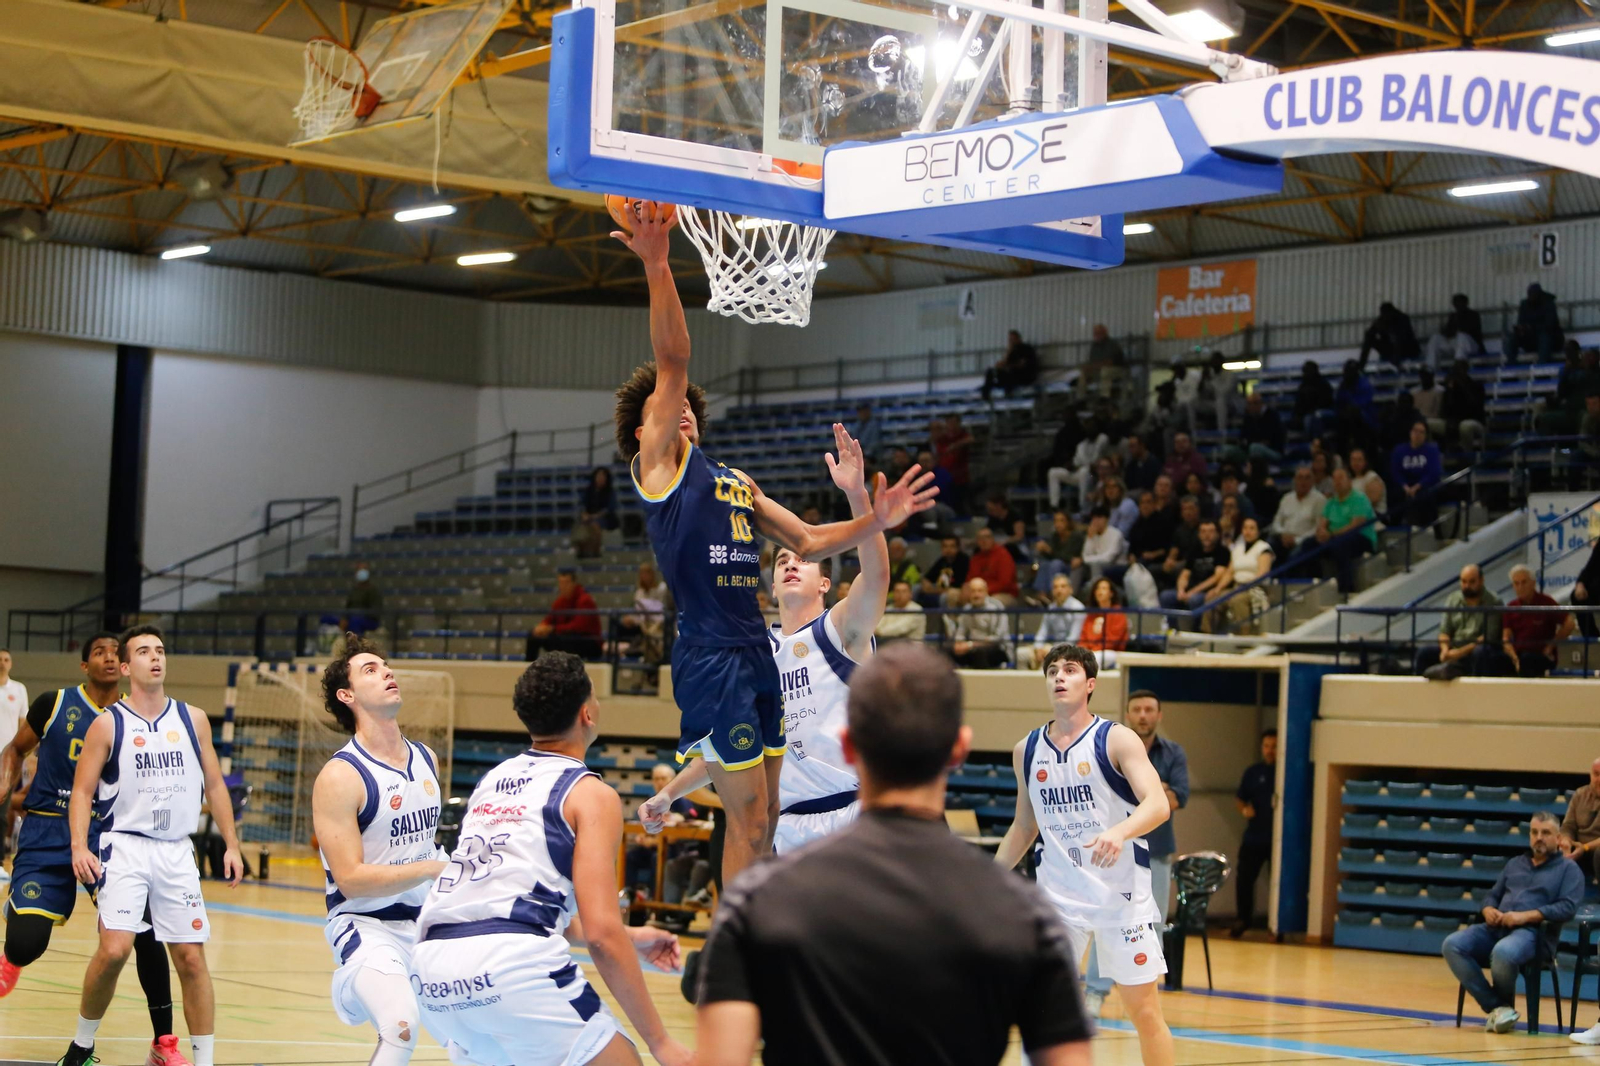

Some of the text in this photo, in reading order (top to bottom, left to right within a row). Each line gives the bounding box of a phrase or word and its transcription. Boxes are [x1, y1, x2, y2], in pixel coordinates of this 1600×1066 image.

[1263, 75, 1363, 131] CLUB
[922, 174, 1040, 204] CENTER
[1542, 232, 1557, 265] B
[1188, 265, 1225, 289] Bar
[963, 290, 976, 316] A
[729, 508, 754, 544] 10
[135, 751, 184, 770] SALLIVER
[1040, 784, 1094, 806] SALLIVER
[152, 809, 171, 831] 10
[1067, 847, 1083, 868] 9
[1124, 933, 1144, 943] Park
[426, 1003, 450, 1013] BEAUTY
